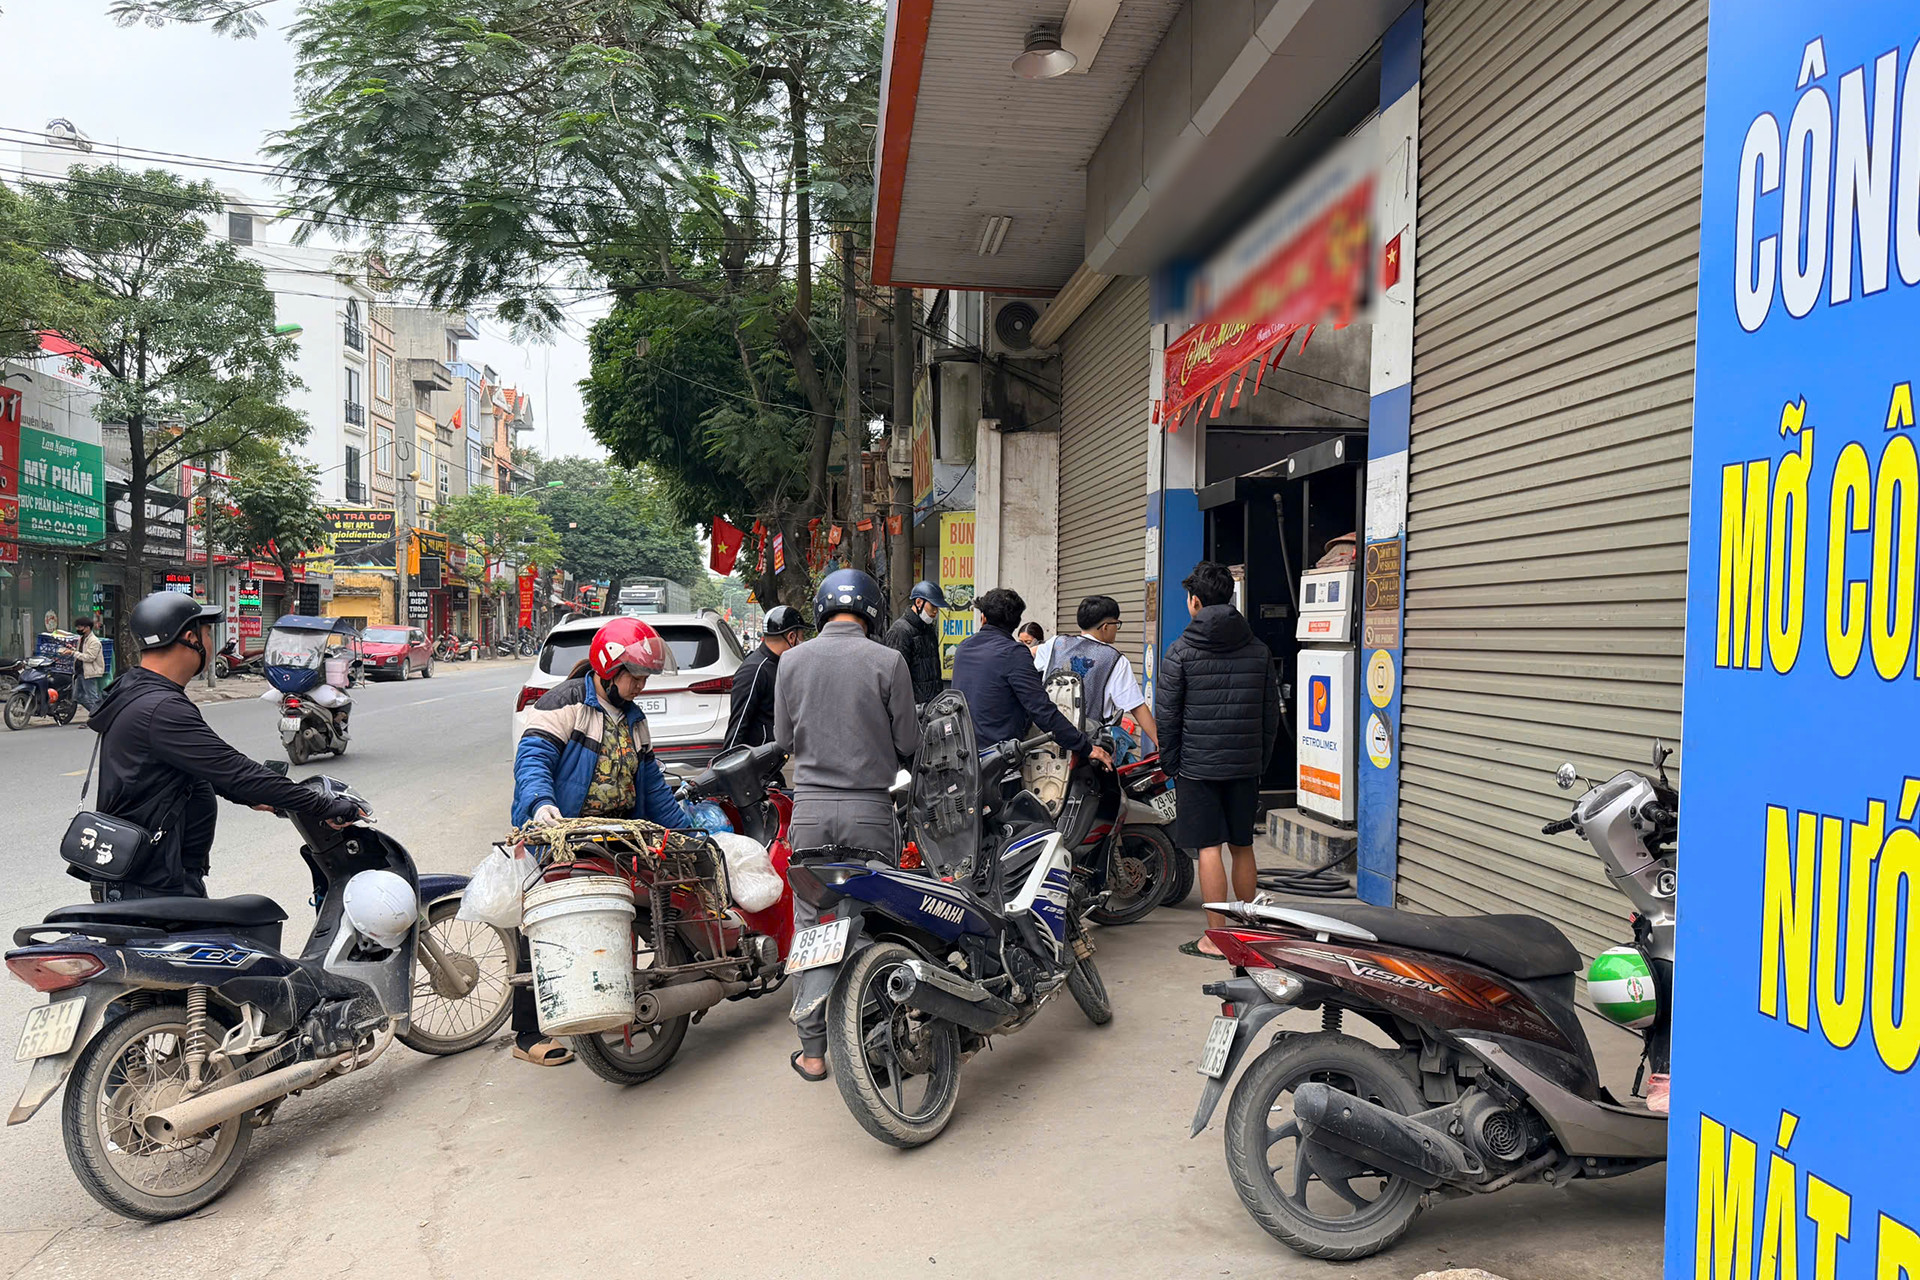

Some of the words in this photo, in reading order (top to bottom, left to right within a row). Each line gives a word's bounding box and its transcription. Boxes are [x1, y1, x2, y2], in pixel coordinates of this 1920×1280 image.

[24, 458, 48, 487] MỸ
[52, 461, 93, 496] PHẨM
[54, 519, 75, 535] CAO
[76, 524, 88, 537] SU
[344, 512, 366, 521] TRẢ
[369, 512, 391, 521] GÓP
[950, 518, 974, 545] BÚN
[1715, 393, 1815, 675] MỠ
[1824, 380, 1920, 682] CÔ
[942, 550, 956, 579] BÒ
[960, 556, 974, 579] HU
[165, 582, 191, 594] IPHONE
[943, 619, 963, 636] NEM
[1302, 735, 1338, 752] PETROLIMEX
[918, 895, 966, 925] YAMAHA
[800, 922, 840, 949] 89-E1
[1338, 954, 1449, 993] VISION
[31, 1002, 74, 1032] 29-Y1
